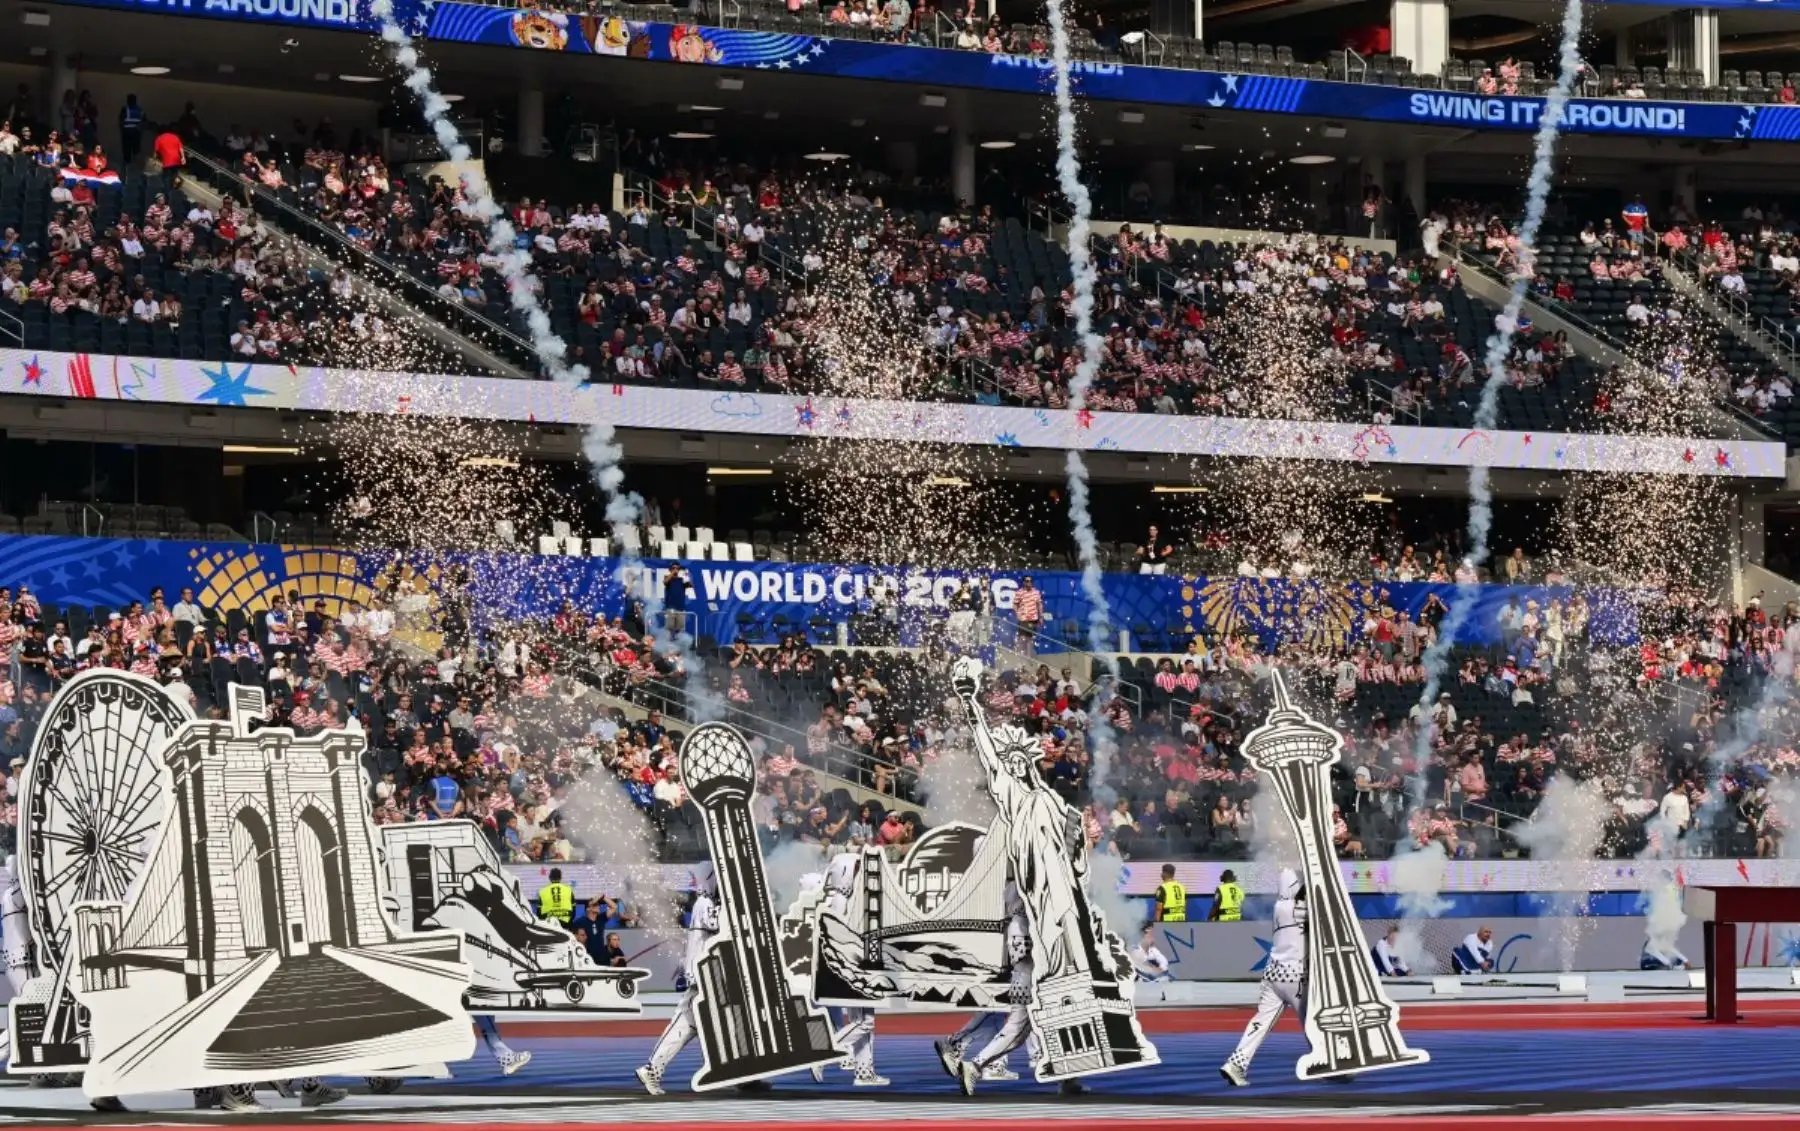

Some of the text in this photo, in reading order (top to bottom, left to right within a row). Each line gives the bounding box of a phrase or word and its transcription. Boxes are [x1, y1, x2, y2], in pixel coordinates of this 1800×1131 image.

[1410, 93, 1505, 121] SWING
[1511, 101, 1540, 124] IT
[701, 569, 827, 604] WORLD
[905, 574, 1019, 610] 206
